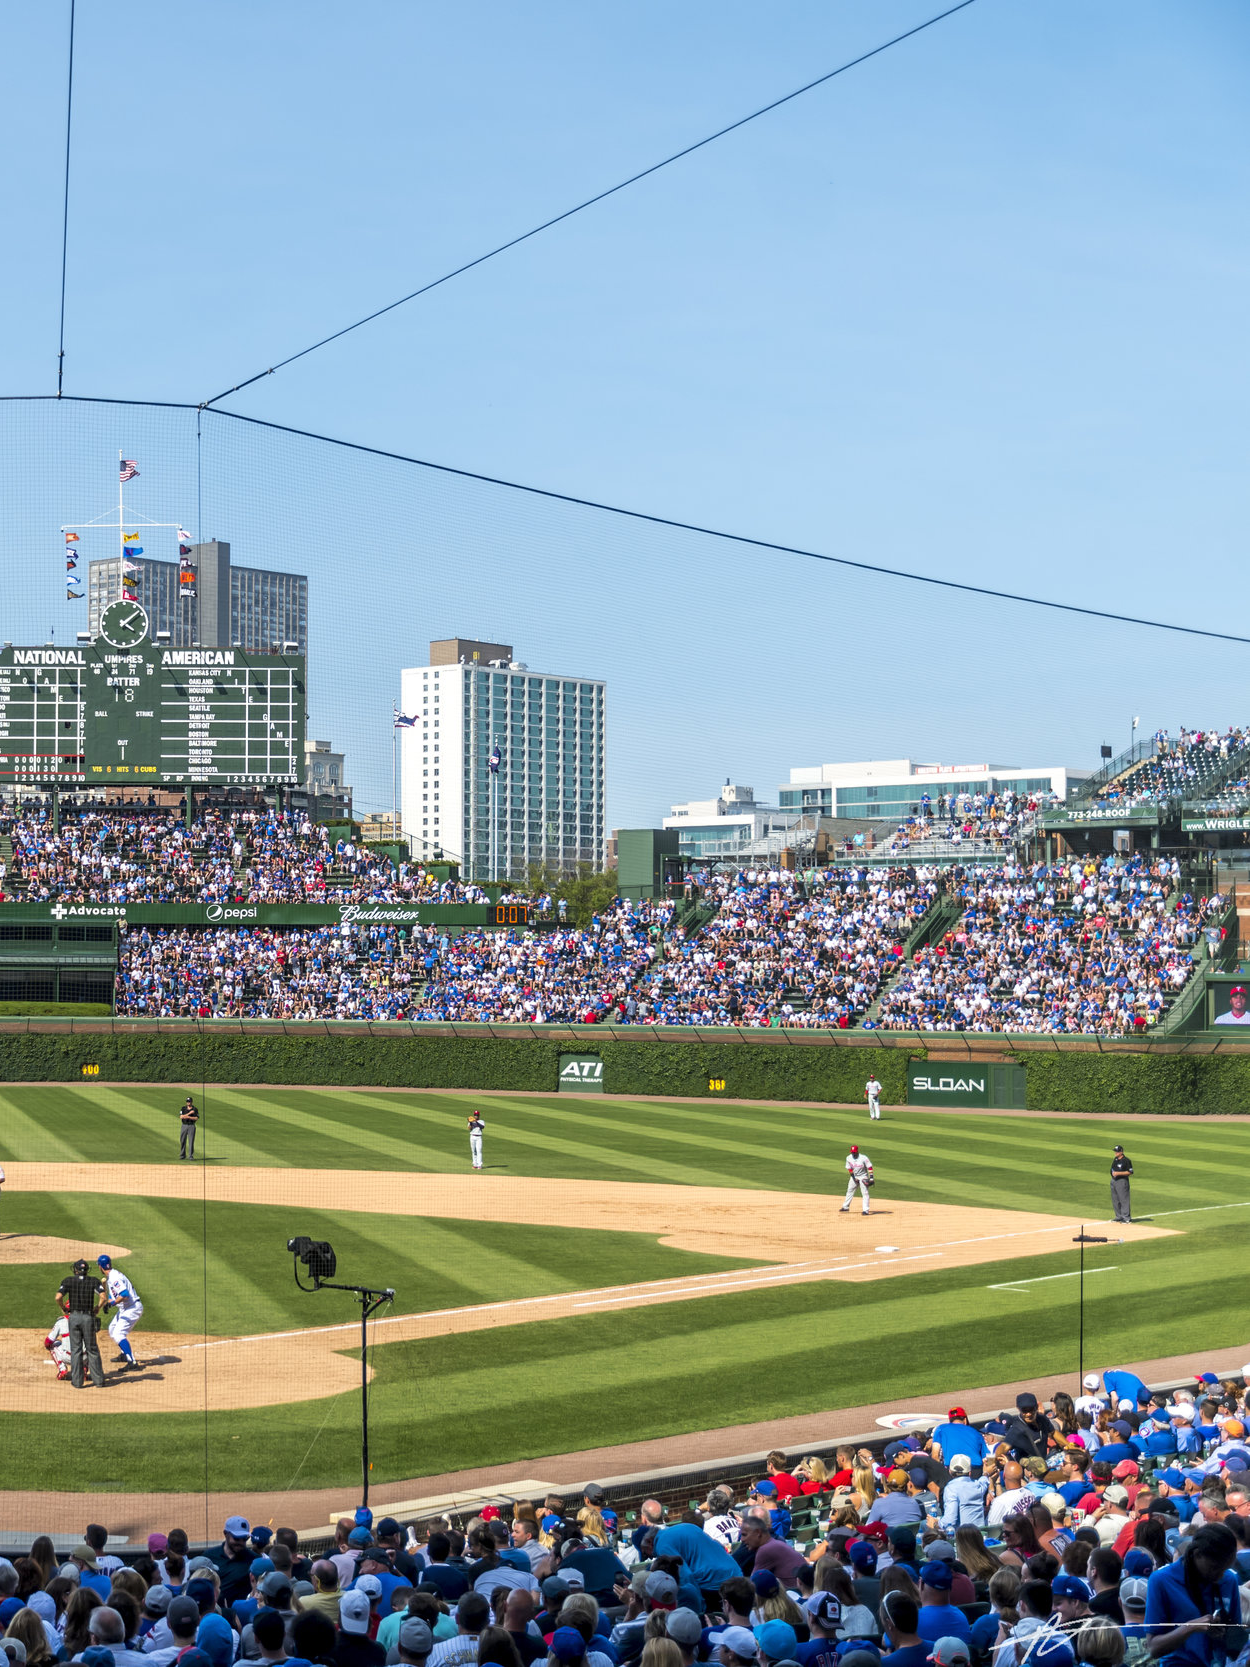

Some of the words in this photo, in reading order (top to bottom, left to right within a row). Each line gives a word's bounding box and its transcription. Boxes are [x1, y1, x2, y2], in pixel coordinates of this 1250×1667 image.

[13, 650, 86, 665] NATIONAL
[104, 654, 143, 664] UMPIRES
[161, 651, 234, 665] AMERICAN
[107, 677, 140, 687] BATTER
[115, 688, 134, 702] 18
[1068, 809, 1131, 819] 773-248-ROOF
[69, 906, 126, 916] Advocate
[224, 907, 257, 919] pepsi
[339, 905, 419, 921] Budweiser
[496, 906, 527, 924] 0:07
[560, 1061, 603, 1076] ATI
[913, 1077, 985, 1092] SLOAN
